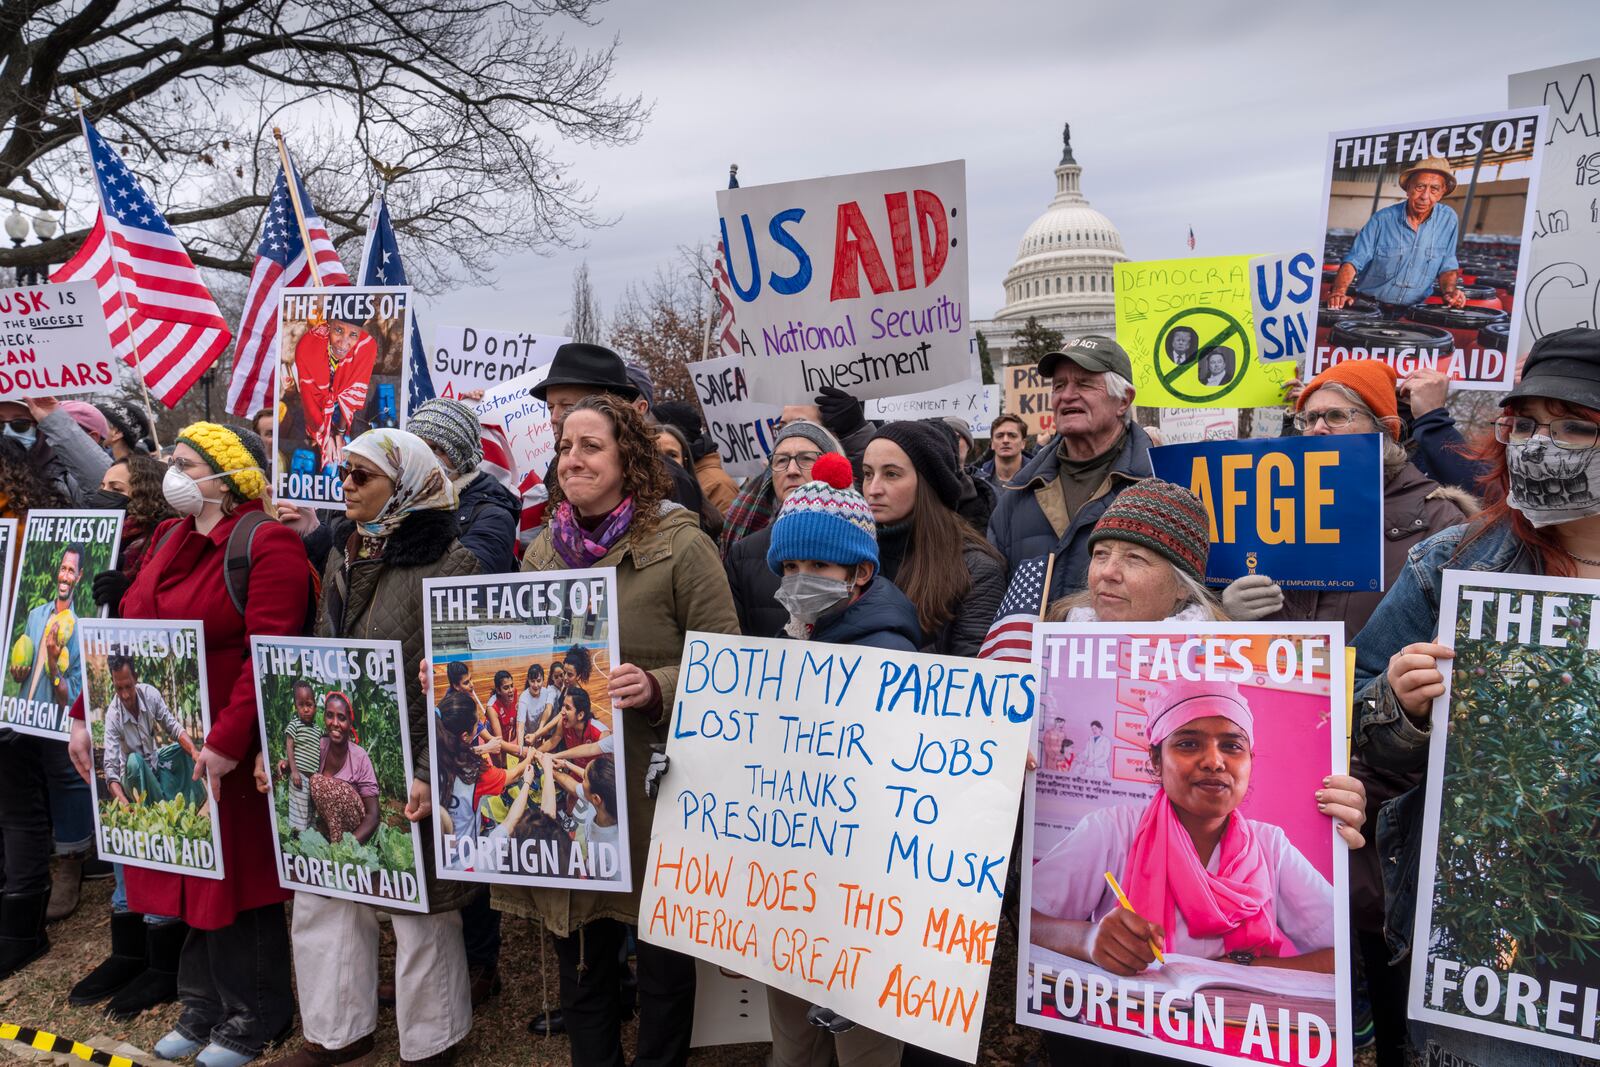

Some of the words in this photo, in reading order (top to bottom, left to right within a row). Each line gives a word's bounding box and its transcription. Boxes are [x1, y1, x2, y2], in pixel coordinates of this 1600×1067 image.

[1337, 136, 1389, 168] THE
[1396, 123, 1483, 163] FACES
[1491, 118, 1535, 154] OF
[720, 208, 813, 302] US
[830, 189, 958, 302] AID:
[58, 291, 76, 305] IS
[1121, 264, 1244, 292] DEMOCRA
[1256, 252, 1315, 311] US
[4, 319, 26, 329] THE
[30, 315, 83, 328] BIGGEST
[284, 295, 318, 320] THE
[322, 294, 375, 320] FACES
[379, 294, 405, 320] OF
[741, 328, 756, 357] A
[762, 314, 857, 357] National
[870, 294, 962, 340] Security
[1124, 296, 1149, 316] DO
[462, 328, 537, 358] Don't
[1079, 339, 1098, 349] ACT
[1448, 348, 1505, 380] AID
[0, 362, 113, 394] DOLLARS
[800, 341, 931, 392] Investment
[504, 401, 547, 432] policy
[876, 397, 947, 414] GOVERNMENT
[525, 440, 553, 462] have
[1190, 450, 1341, 546] AFGE
[29, 518, 54, 542] THE
[54, 517, 96, 543] FACES
[96, 518, 118, 544] OF
[432, 587, 480, 622] THE
[486, 580, 563, 620] FACES
[569, 579, 606, 616] OF
[1460, 590, 1570, 649] THE
[83, 628, 116, 656] THE
[118, 629, 172, 658] FACES
[172, 630, 196, 659] OF
[486, 631, 512, 640] USAID
[257, 646, 297, 677] THE
[301, 647, 362, 681] FACES
[365, 649, 394, 682] OF
[685, 639, 786, 701] BOTH
[795, 649, 862, 707] MY
[875, 660, 1036, 723] PARENTS
[1046, 637, 1118, 680] THE
[1129, 638, 1253, 683] FACES
[1265, 638, 1326, 685] OF
[0, 695, 58, 730] FOREIGN
[675, 700, 760, 745] LOST
[779, 715, 873, 765] THEIR
[891, 732, 998, 776] JOBS
[745, 764, 858, 813] THANKS
[885, 785, 939, 825] TO
[101, 825, 177, 864] FOREIGN
[181, 837, 215, 870] AID
[443, 834, 561, 877] FOREIGN
[567, 839, 621, 879] AID
[677, 789, 860, 858] PRESIDENT
[886, 831, 1005, 899] MUSK
[282, 851, 374, 896] FOREIGN
[378, 867, 418, 902] AID
[653, 842, 734, 899] HOW
[746, 861, 818, 913] DOES
[838, 882, 904, 936] THIS
[922, 907, 997, 966] MAKE
[649, 896, 758, 958] AMERICA
[771, 926, 872, 991] GREAT
[878, 963, 980, 1034] AGAIN
[1031, 961, 1226, 1050] FOREIGN
[1239, 1001, 1333, 1067] AID
